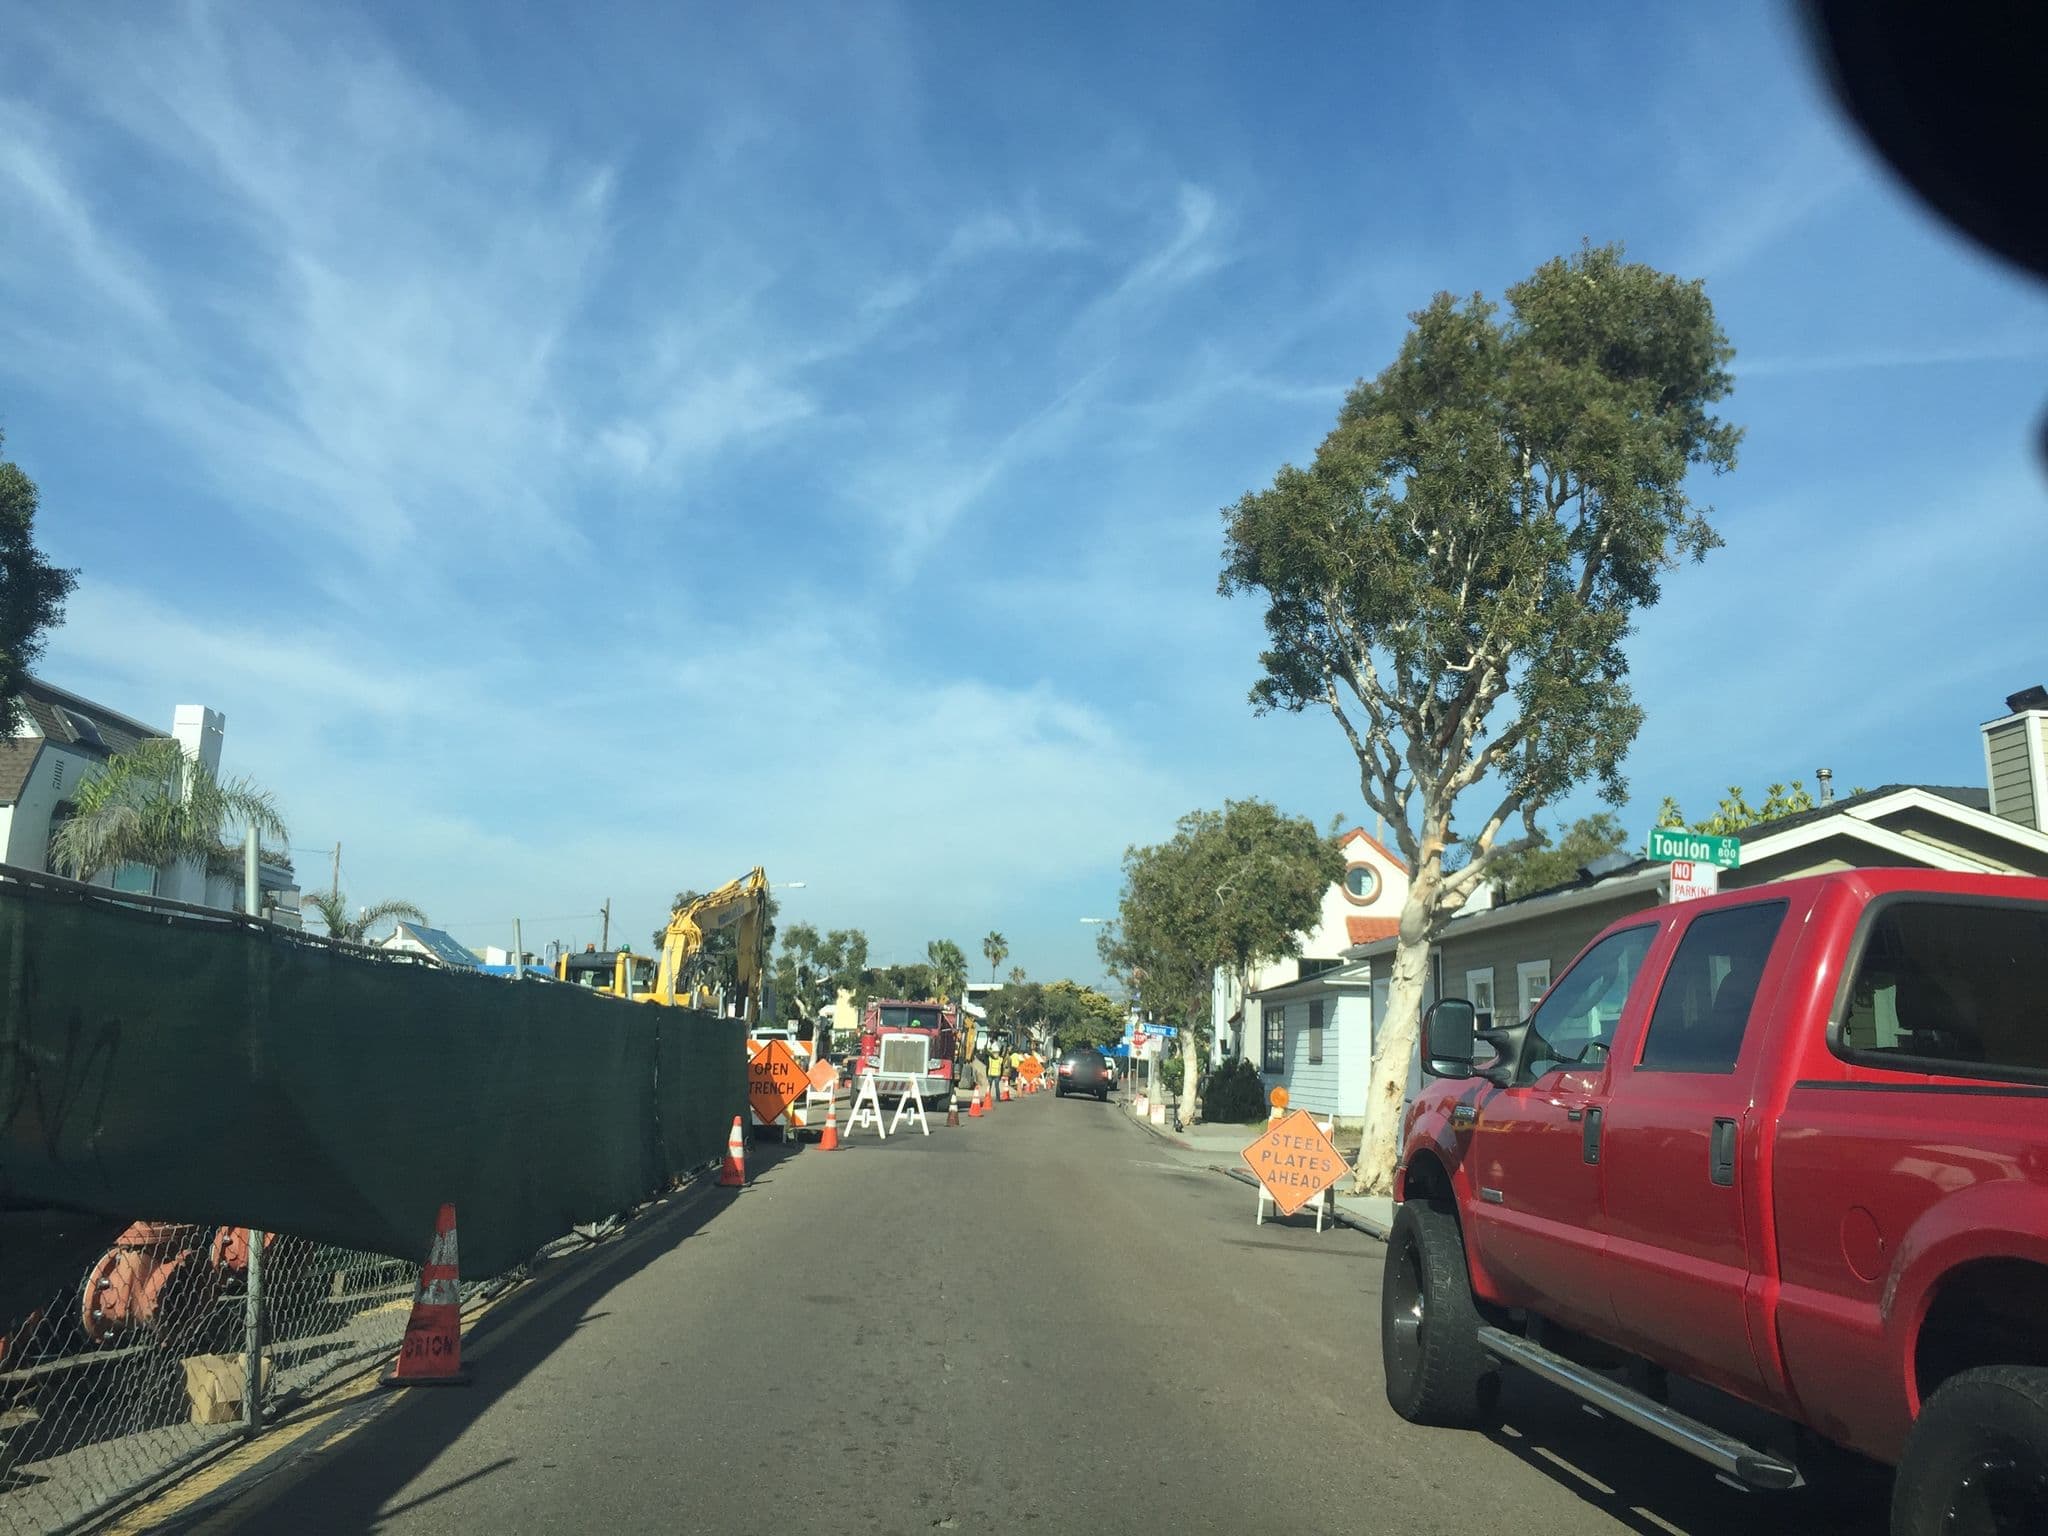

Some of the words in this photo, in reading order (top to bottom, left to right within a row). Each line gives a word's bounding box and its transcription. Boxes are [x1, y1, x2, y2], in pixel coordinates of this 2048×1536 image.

[1654, 834, 1710, 860] Toulon
[1718, 847, 1736, 858] 800
[1674, 863, 1690, 879] NO
[754, 1062, 789, 1076] OPEN
[749, 1082, 795, 1095] TRENCH
[1271, 1133, 1324, 1153] STEEL
[1261, 1150, 1331, 1172] PLATES
[1267, 1169, 1321, 1189] AHEAD
